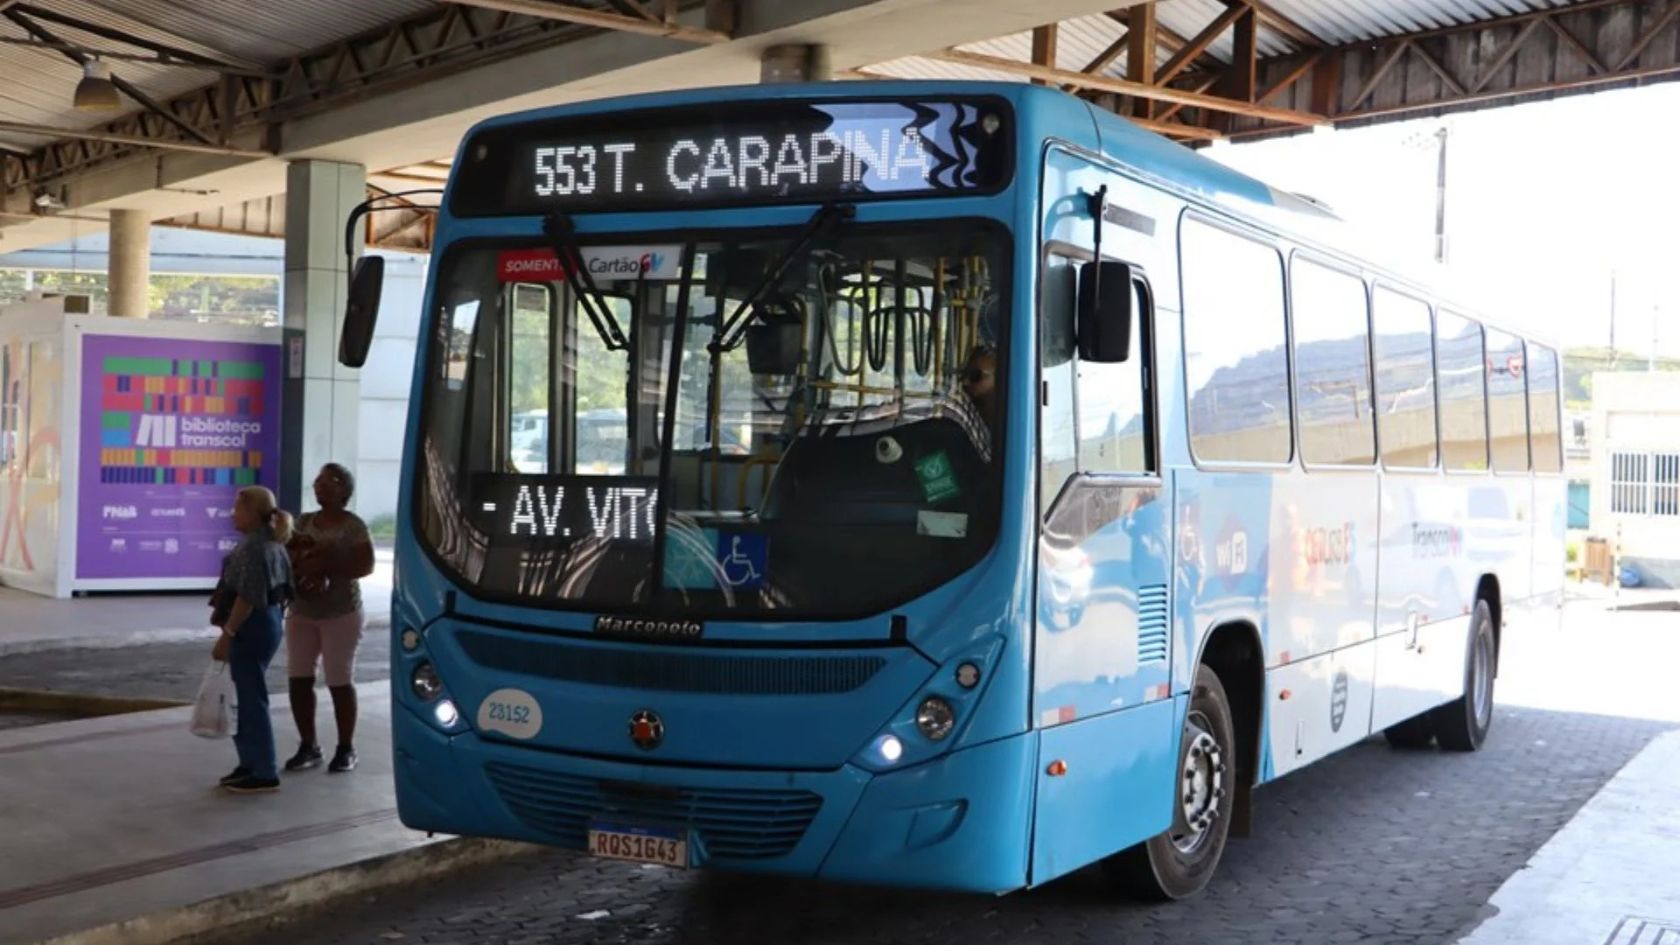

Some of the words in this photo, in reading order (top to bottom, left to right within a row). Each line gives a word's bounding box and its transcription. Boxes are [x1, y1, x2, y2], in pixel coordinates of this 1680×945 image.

[535, 146, 596, 196] 553
[604, 143, 643, 193] T.
[666, 126, 930, 191] CARAPINA
[505, 258, 564, 272] SOMENT
[181, 417, 261, 434] biblioteca
[181, 433, 246, 447] transcol
[511, 485, 571, 536] AV.
[597, 616, 701, 636] Marcopolo
[488, 702, 530, 724] 23152
[596, 832, 677, 862] RQS1G43
